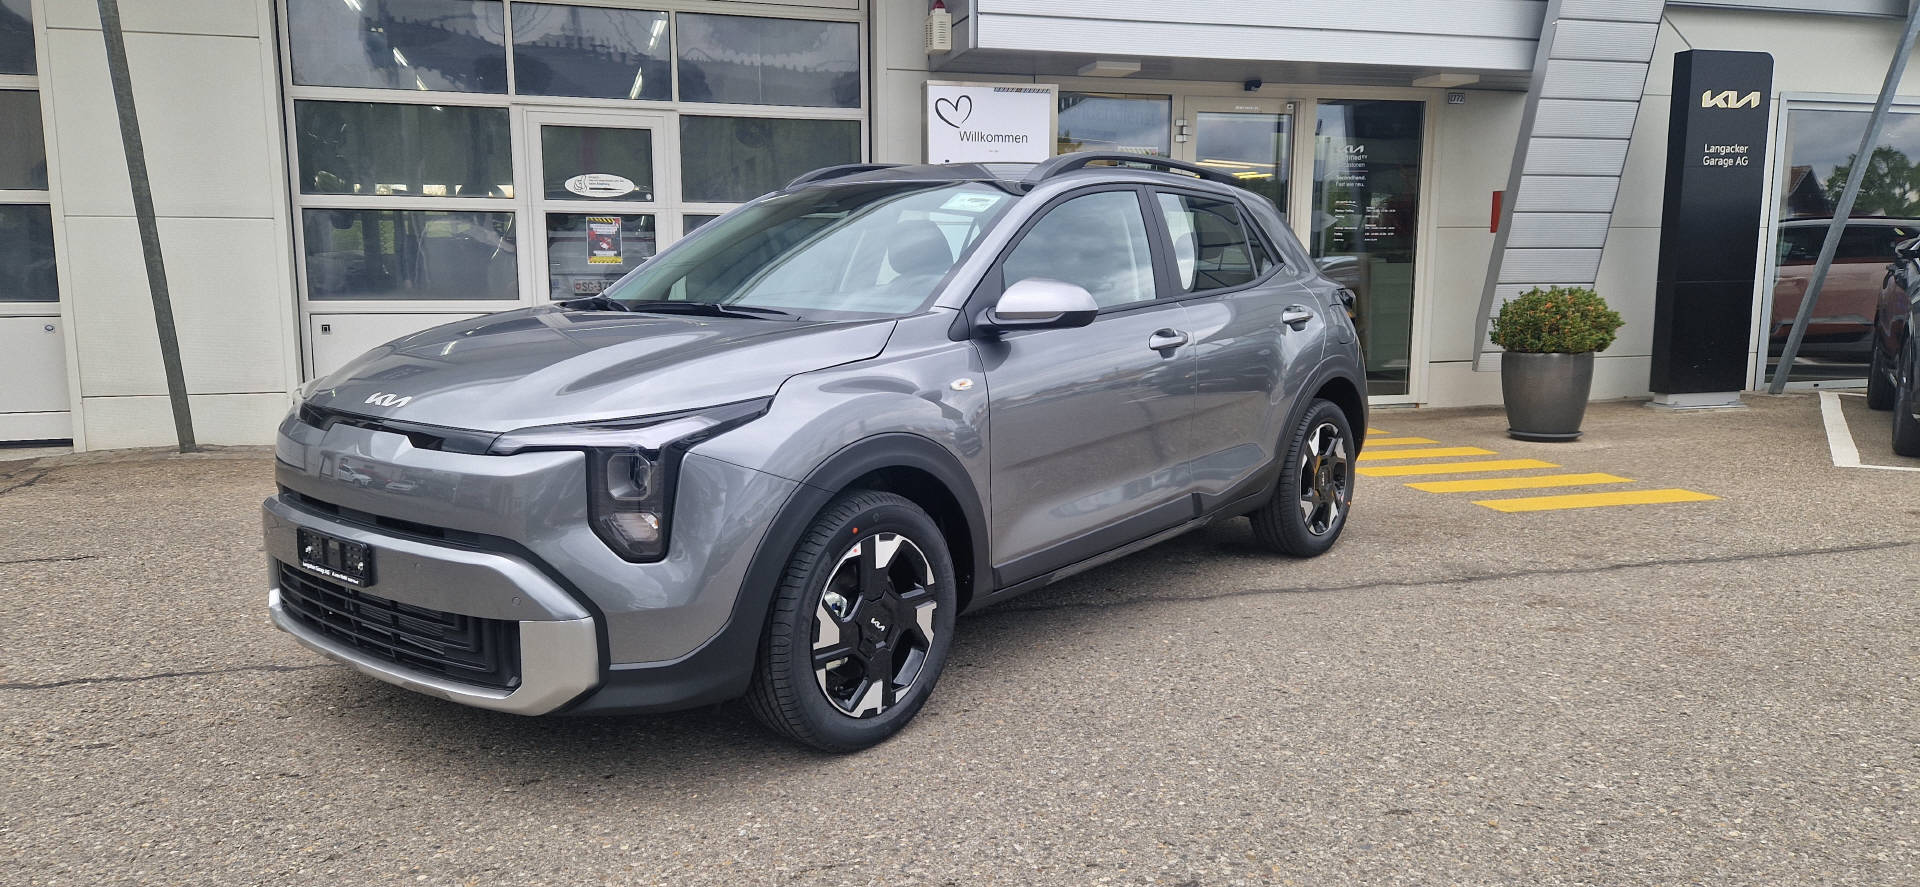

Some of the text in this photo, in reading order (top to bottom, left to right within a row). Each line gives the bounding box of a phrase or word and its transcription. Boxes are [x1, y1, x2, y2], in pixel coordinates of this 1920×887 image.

[1702, 90, 1760, 109] KIA
[959, 131, 1028, 143] Willkommen
[1704, 144, 1748, 155] Langacker
[1703, 156, 1749, 168] Garage AG
[364, 391, 412, 408] KIA
[871, 617, 885, 631] KIA
